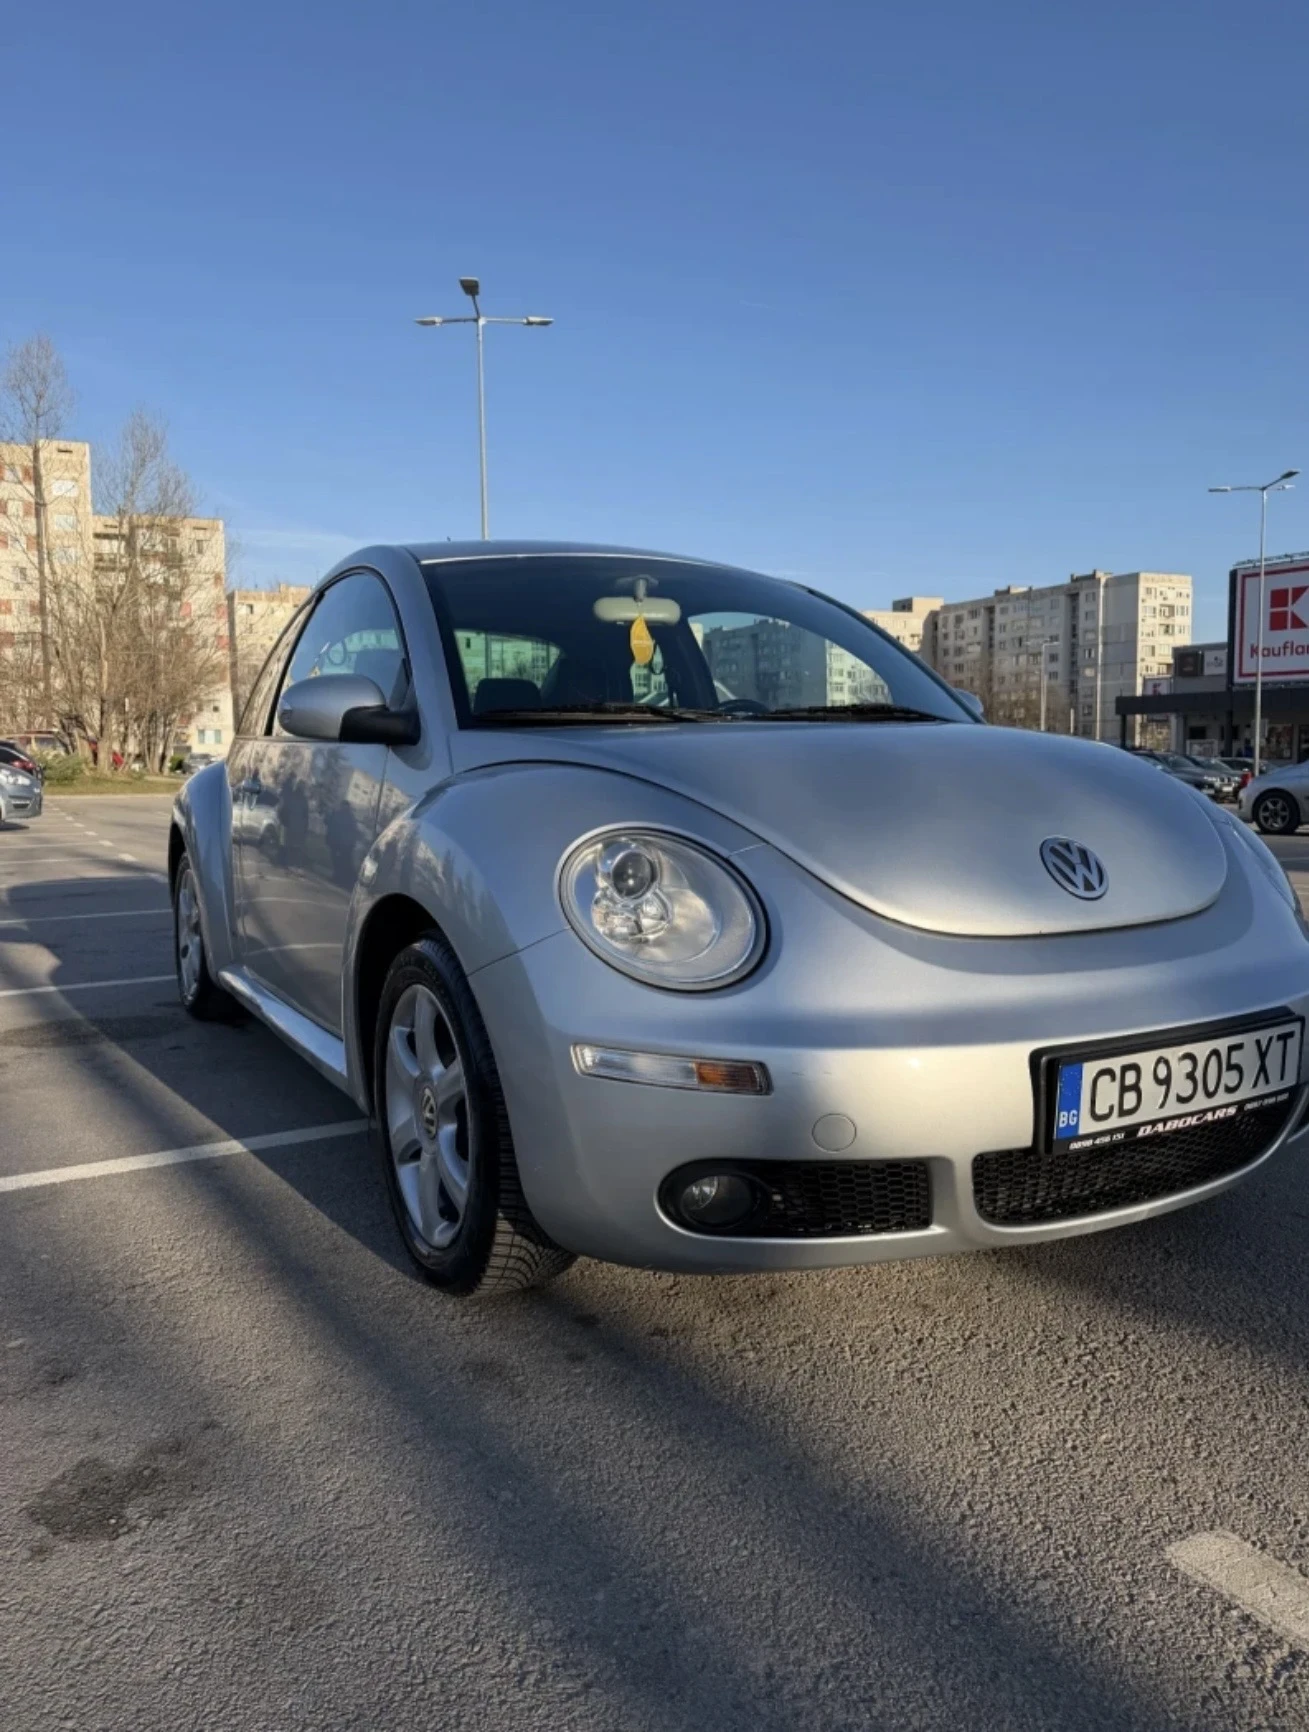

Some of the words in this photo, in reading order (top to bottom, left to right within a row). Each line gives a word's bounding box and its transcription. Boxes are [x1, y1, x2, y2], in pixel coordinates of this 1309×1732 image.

[1250, 640, 1309, 659] Kaufla
[1089, 1062, 1143, 1122] CB
[1152, 1042, 1245, 1109] 9305
[1251, 1031, 1295, 1089] XT
[1059, 1109, 1078, 1128] BG
